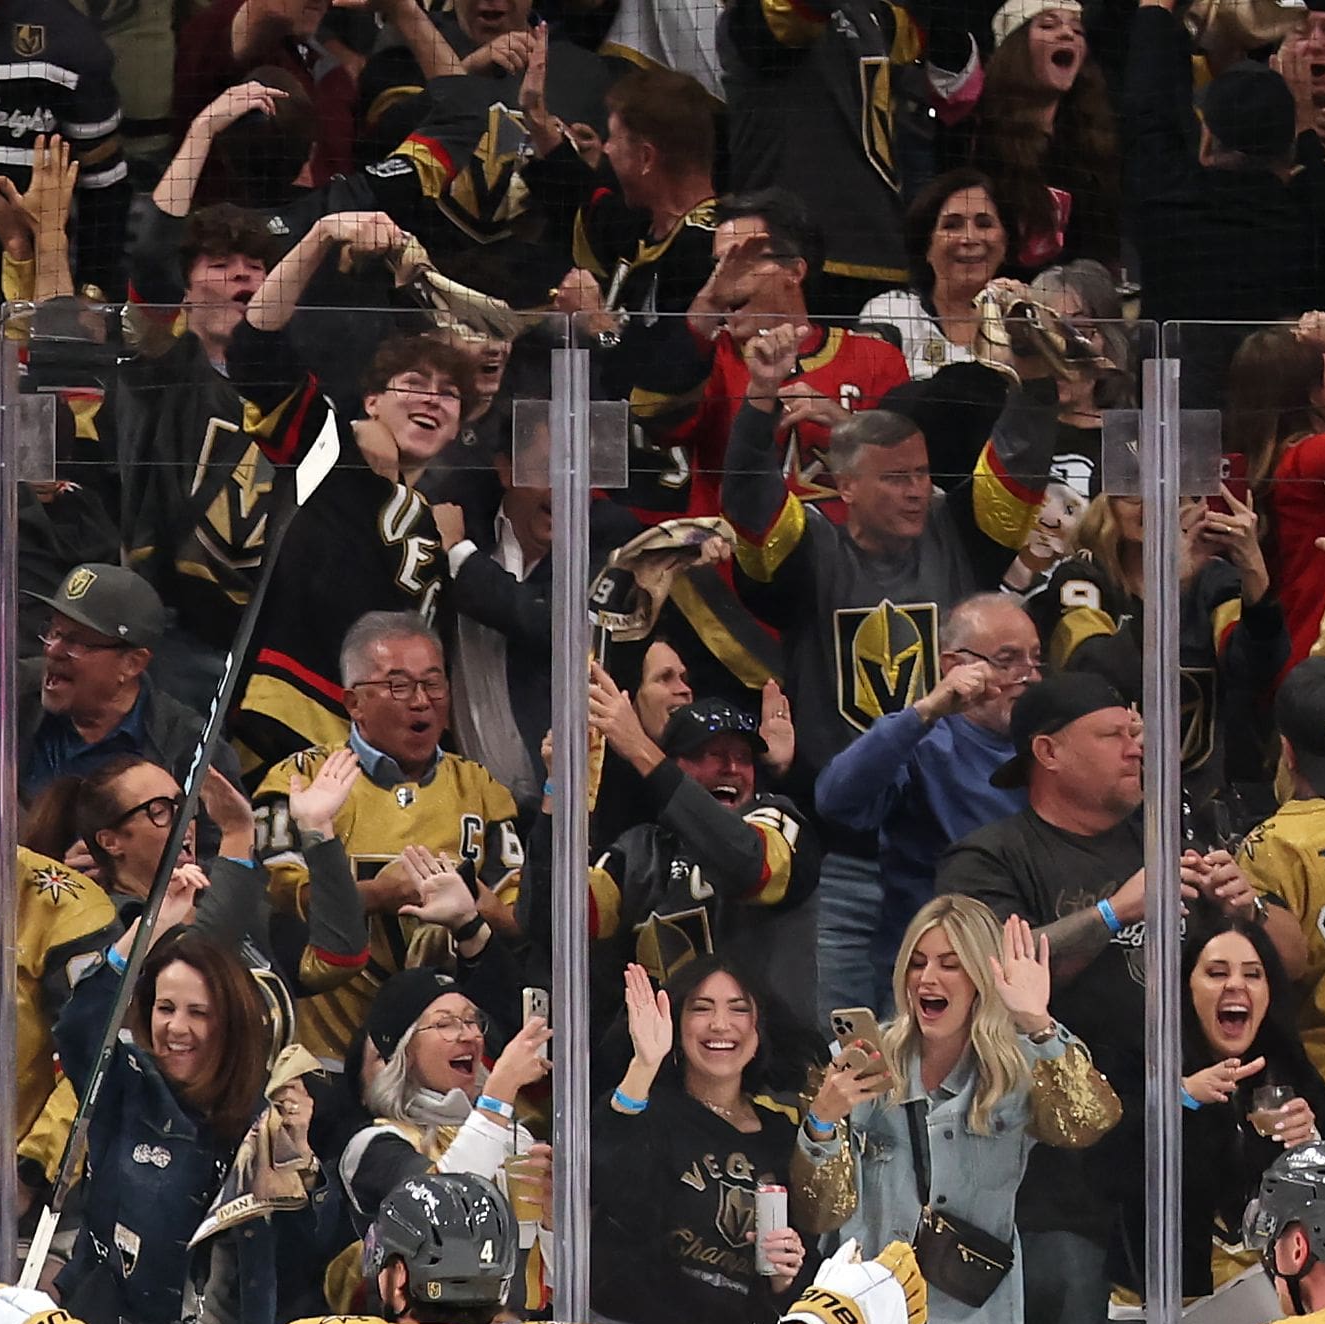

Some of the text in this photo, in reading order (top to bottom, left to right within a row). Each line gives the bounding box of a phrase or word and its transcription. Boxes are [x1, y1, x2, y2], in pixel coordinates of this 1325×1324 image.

[458, 812, 485, 862] C
[499, 819, 526, 869] 6
[680, 1152, 757, 1192] VEG
[479, 1239, 495, 1264] 4
